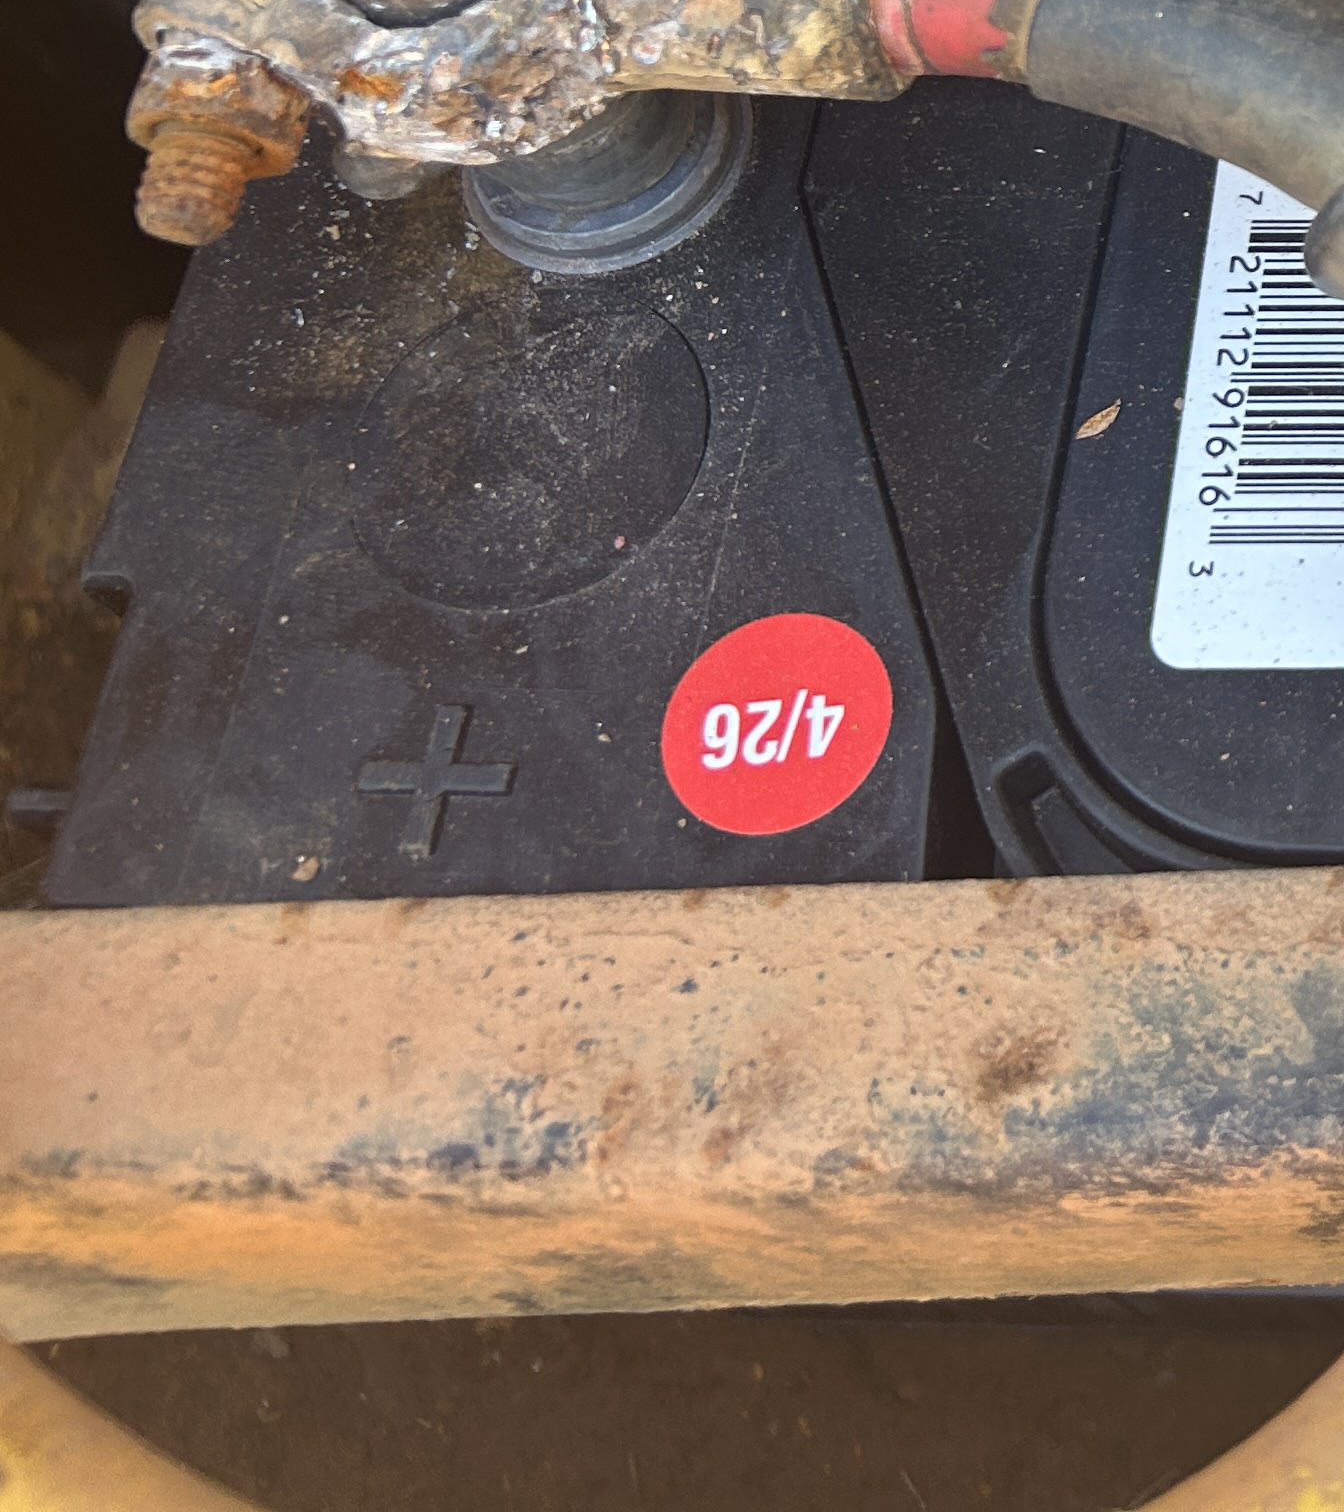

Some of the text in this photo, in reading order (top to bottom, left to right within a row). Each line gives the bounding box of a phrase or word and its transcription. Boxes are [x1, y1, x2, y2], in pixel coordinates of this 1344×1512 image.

[1188, 191, 1262, 578] 7 21112 91616 3
[701, 689, 845, 770] 4/26
